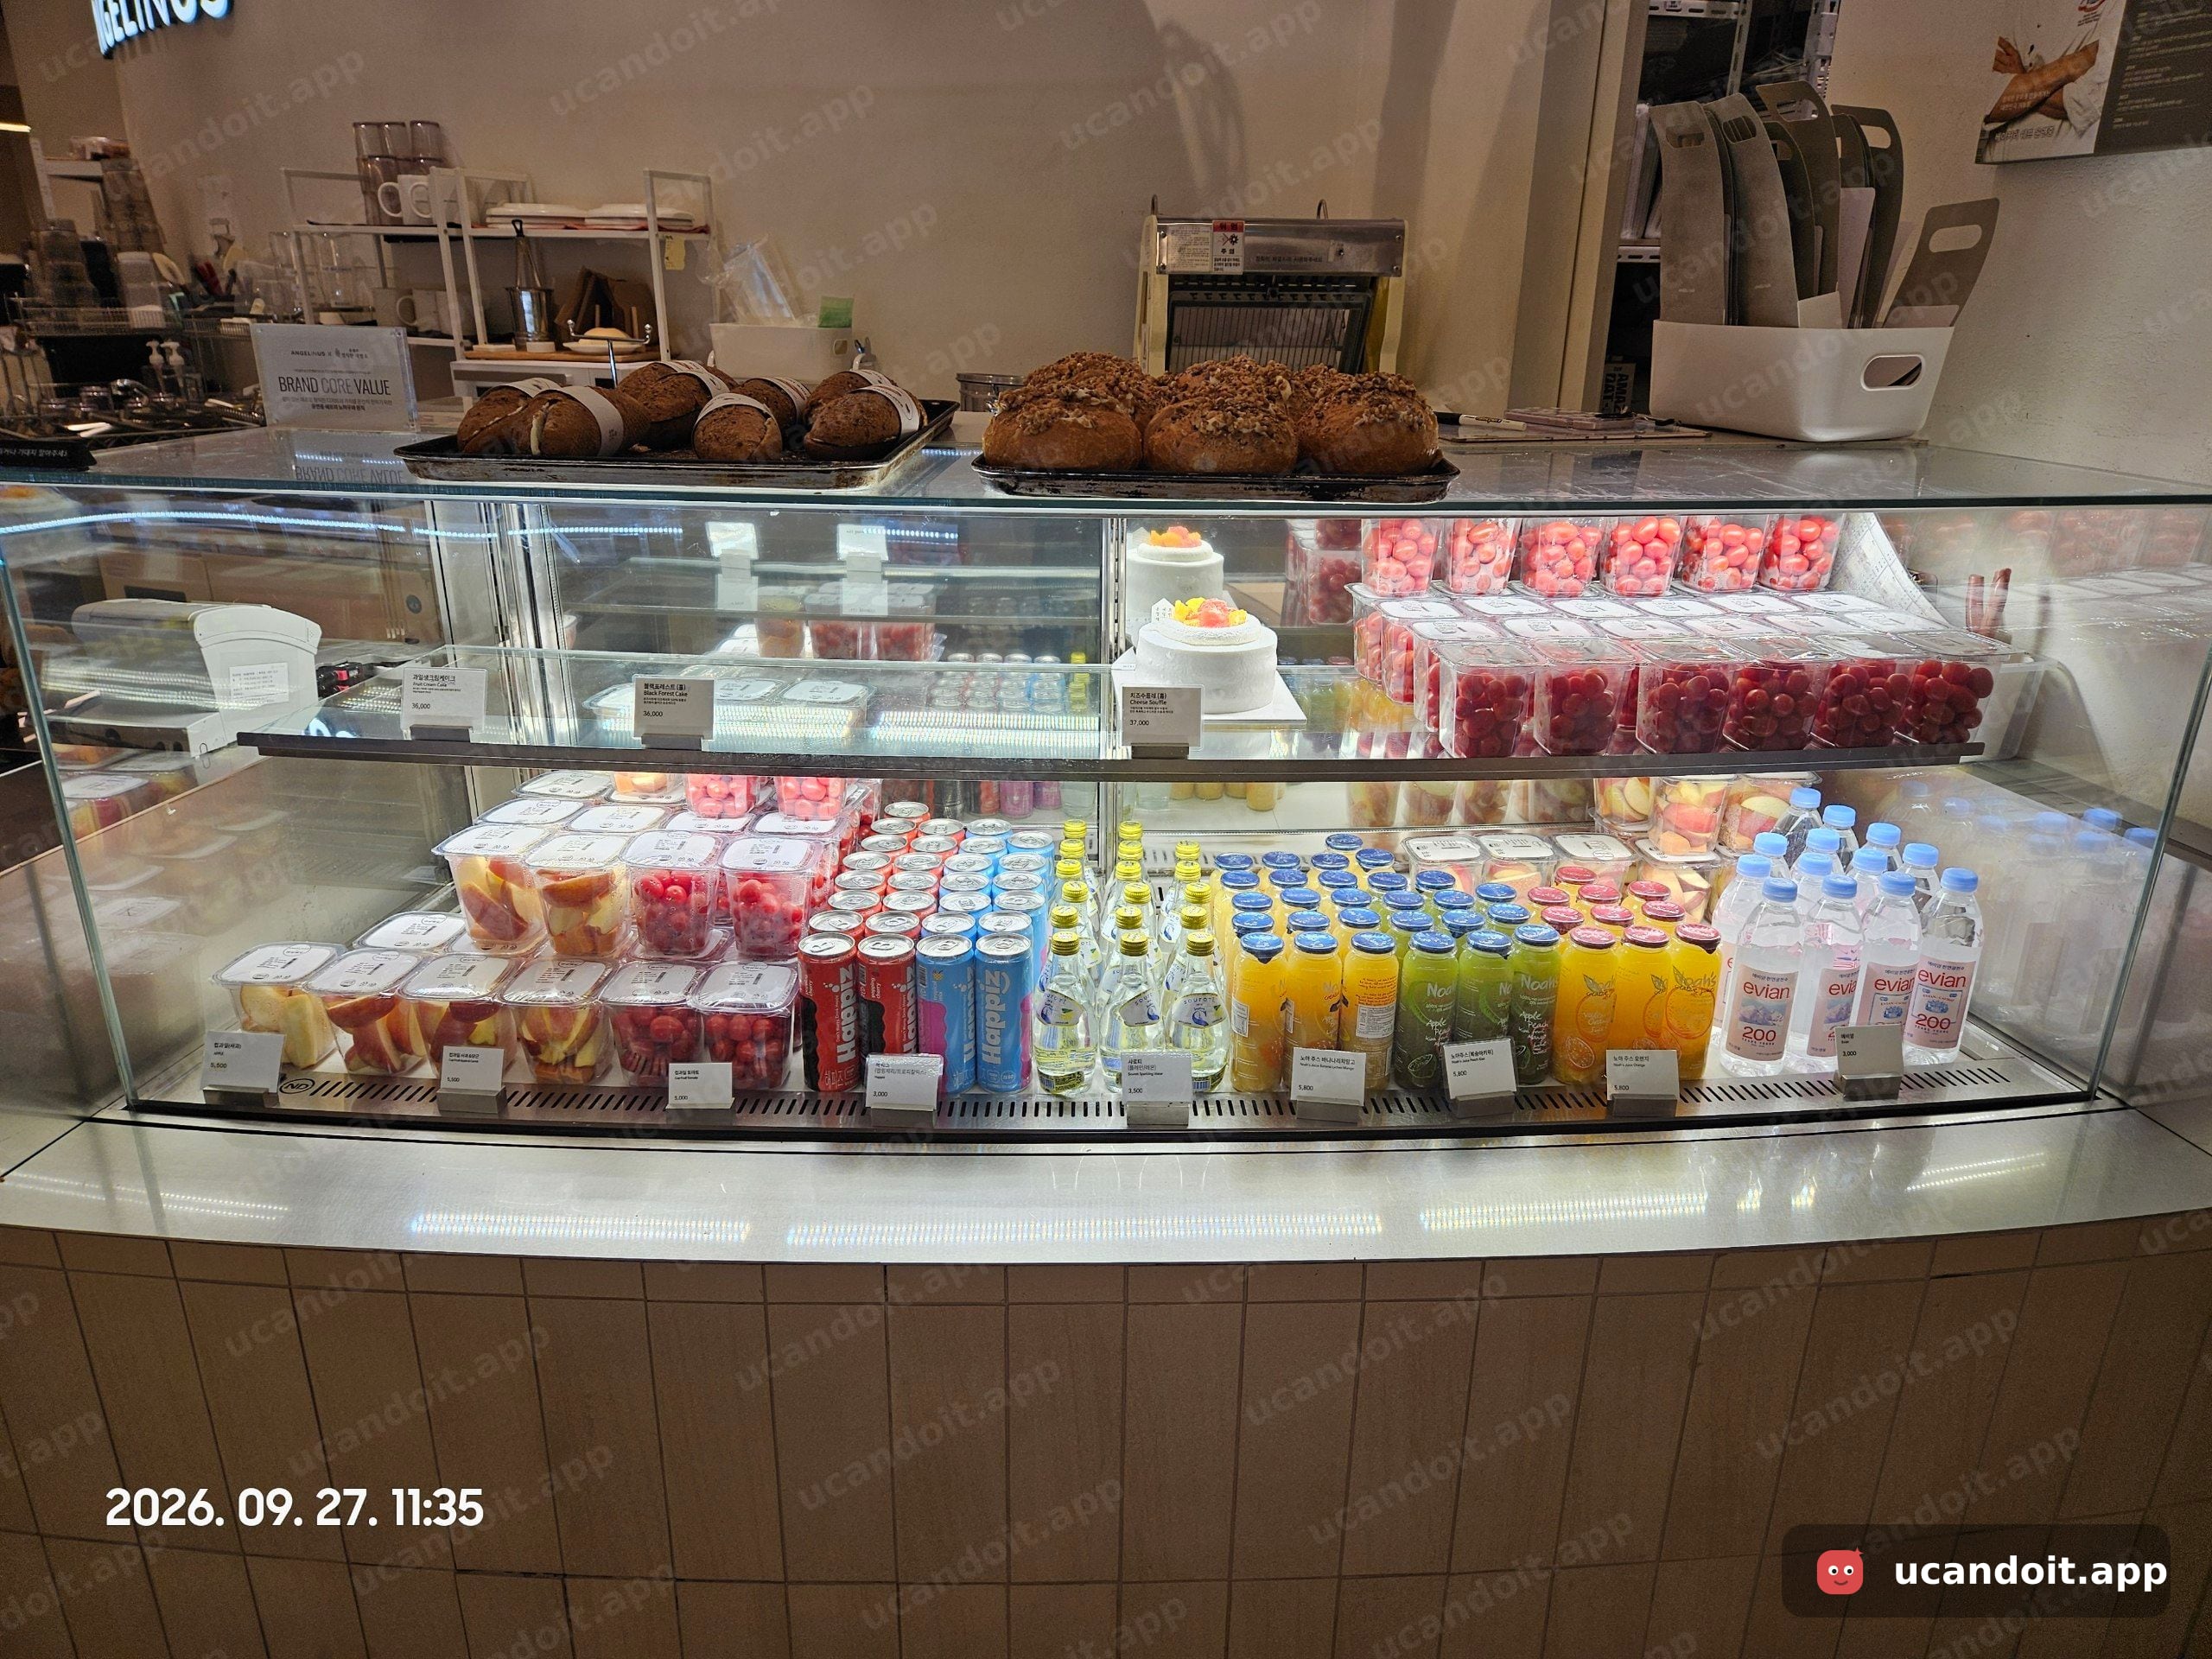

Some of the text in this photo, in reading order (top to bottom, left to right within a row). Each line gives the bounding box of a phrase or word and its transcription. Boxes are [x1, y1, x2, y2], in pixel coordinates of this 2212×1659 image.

[278, 376, 391, 395] BRAND CORE VALUE
[1917, 969, 1967, 988] evian
[1743, 982, 1789, 1000] evian
[1828, 980, 1857, 995] evia
[837, 963, 857, 1065] Happiz
[982, 969, 1007, 1065] Happiz
[1519, 1010, 1542, 1023] Apple
[1916, 1013, 1951, 1030] 200
[1426, 1018, 1446, 1030] Apple
[1528, 1020, 1548, 1029] Peach
[1742, 1026, 1777, 1042] 200
